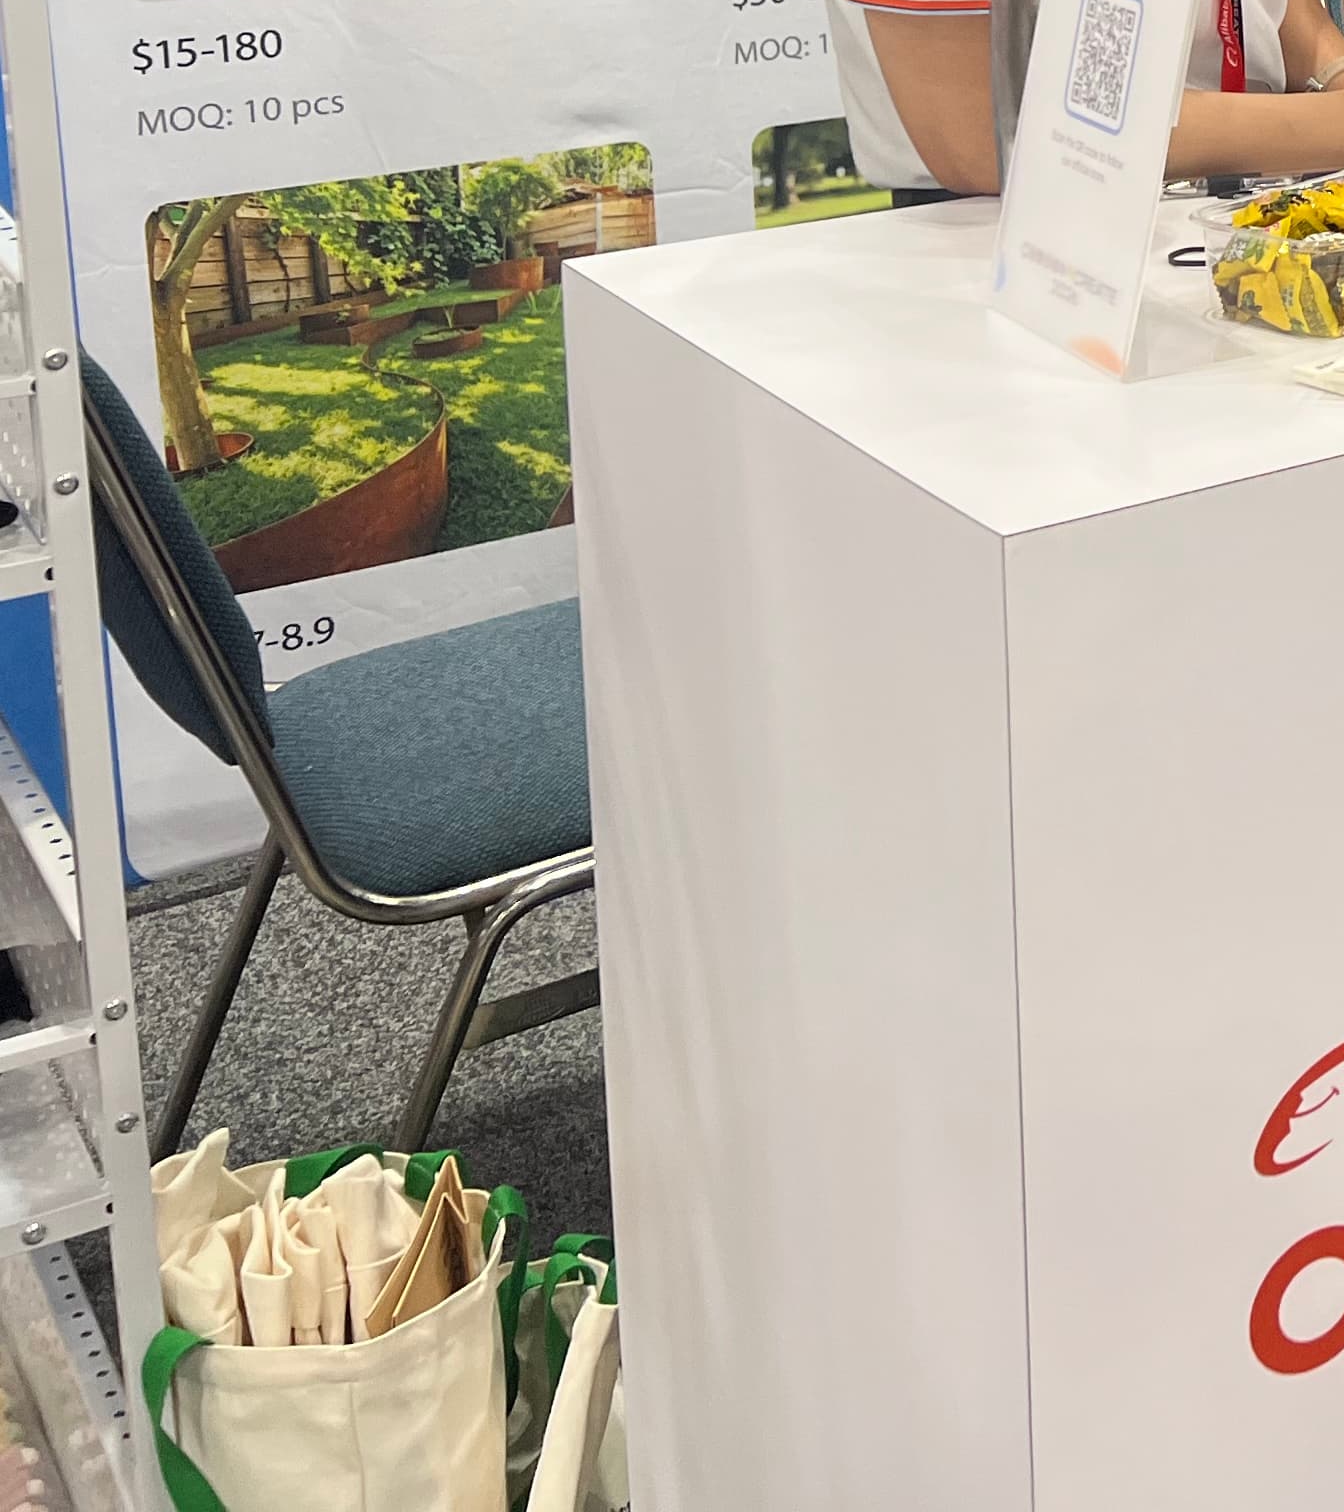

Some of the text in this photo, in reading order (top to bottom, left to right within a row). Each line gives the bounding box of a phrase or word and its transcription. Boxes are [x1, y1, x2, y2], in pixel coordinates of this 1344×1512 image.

[132, 29, 282, 75] $15-180
[735, 35, 810, 65] MOQ:
[138, 95, 344, 136] MOQ: 10 pcs
